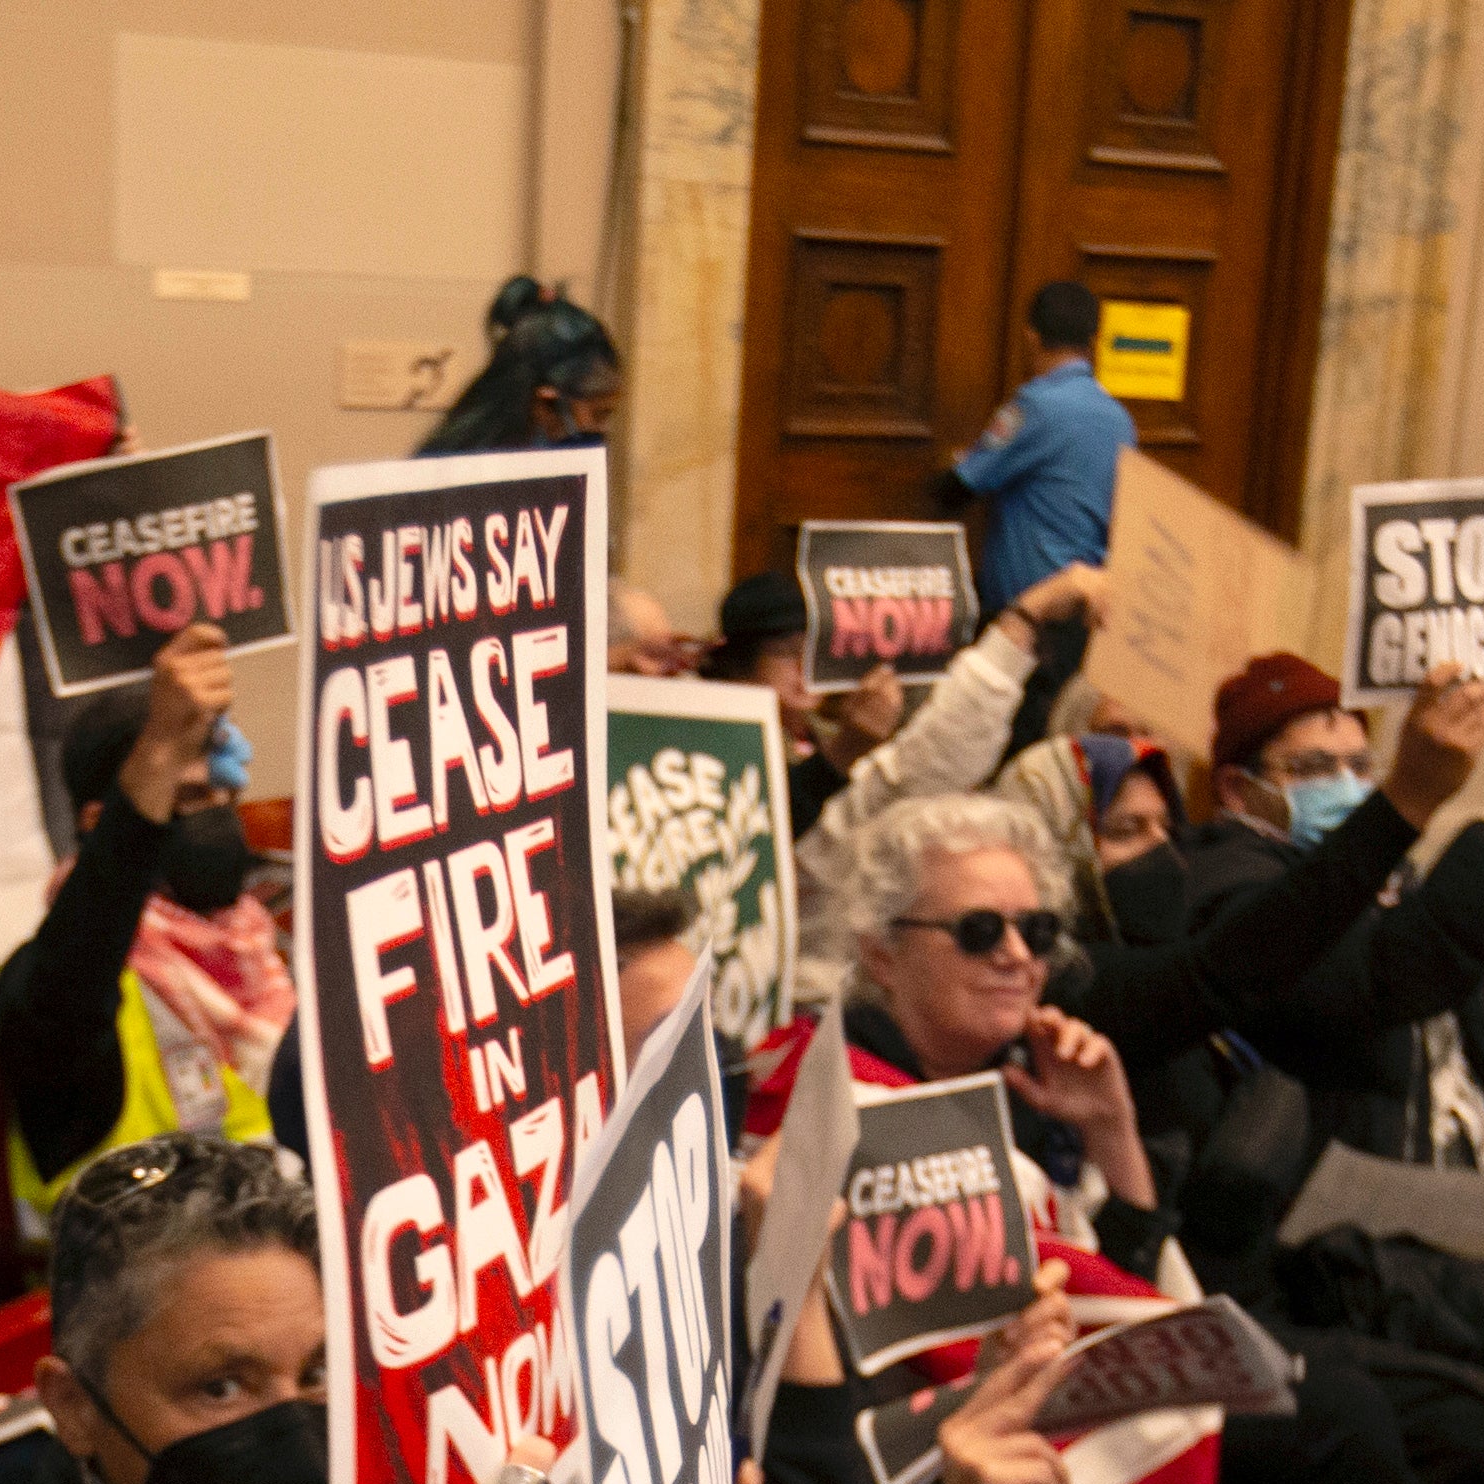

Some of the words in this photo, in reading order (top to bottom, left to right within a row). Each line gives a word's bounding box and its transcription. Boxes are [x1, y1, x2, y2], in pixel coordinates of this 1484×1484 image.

[59, 491, 259, 567] CEASEFIRE
[368, 517, 477, 643] JEWS
[484, 504, 568, 617] SAY
[823, 565, 955, 598] CEASEFIRE
[69, 533, 265, 646] NOW.
[317, 623, 575, 864] CEASE
[345, 816, 576, 1073] FIRE
[468, 1027, 527, 1114] IN
[849, 1144, 1001, 1217] CEASEFIRE
[848, 1190, 1022, 1317] NOW.
